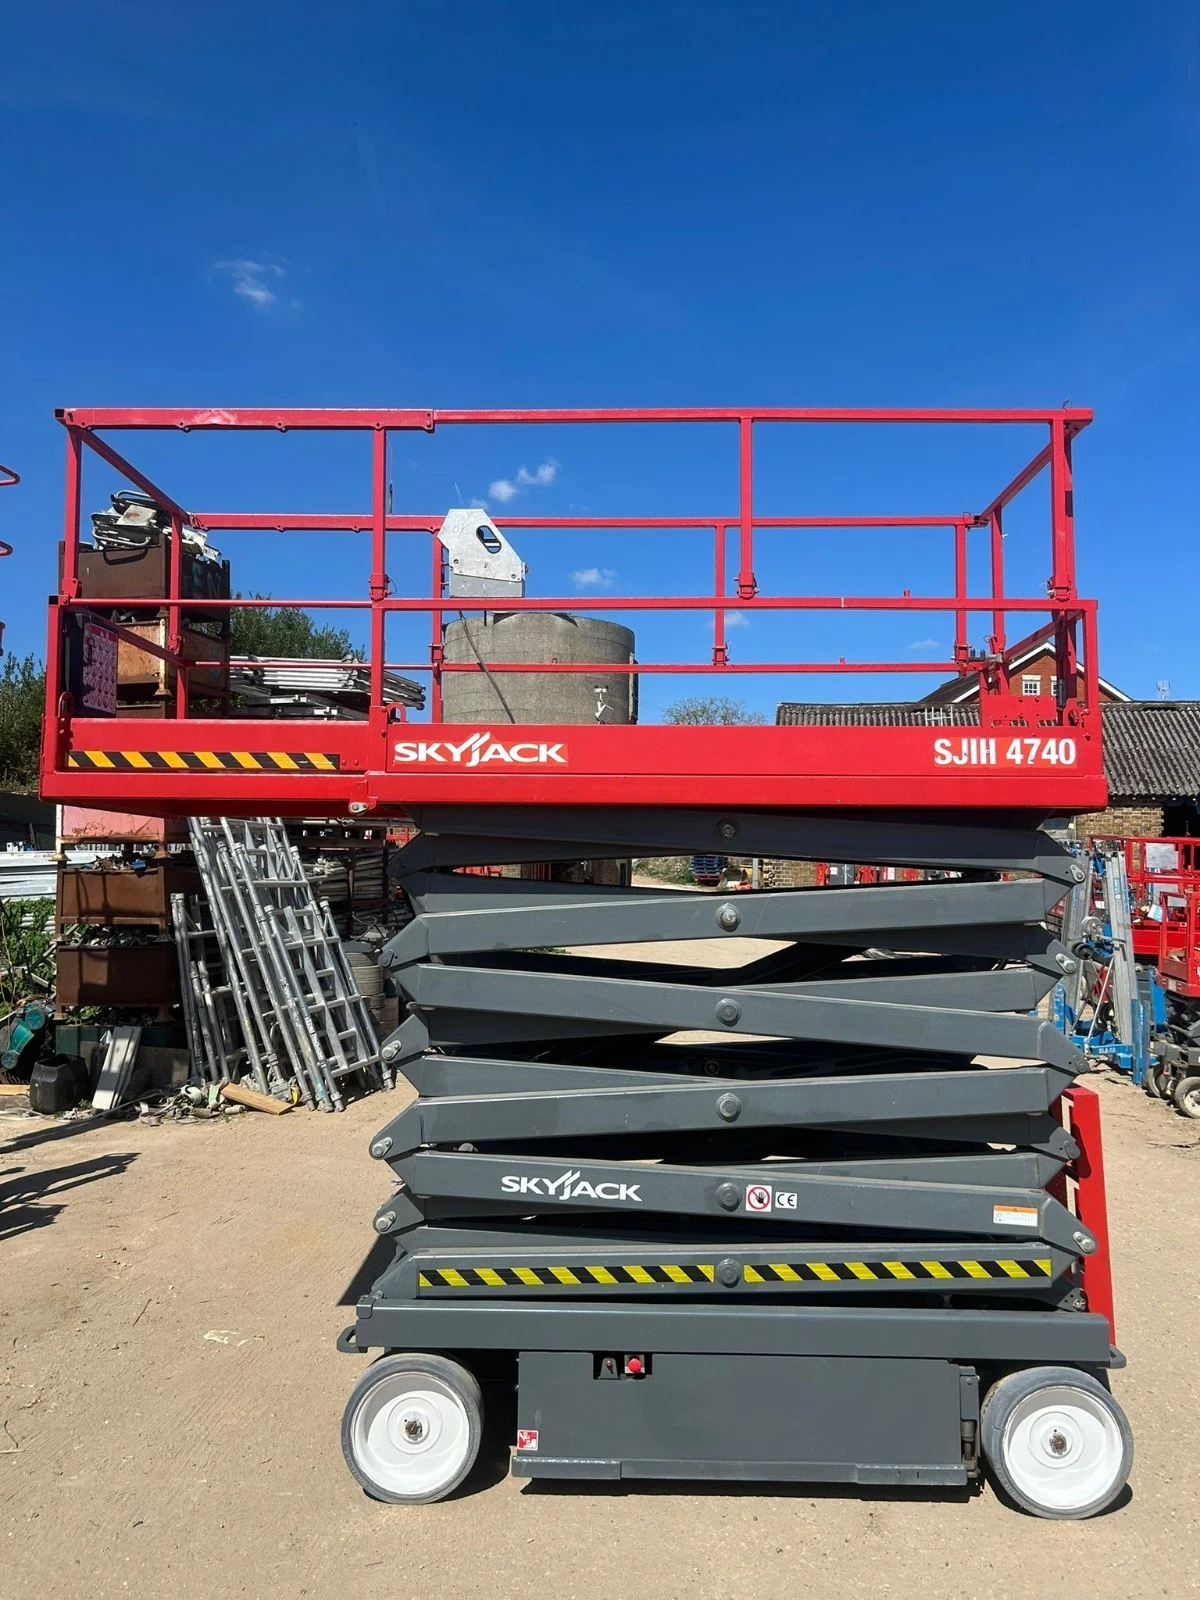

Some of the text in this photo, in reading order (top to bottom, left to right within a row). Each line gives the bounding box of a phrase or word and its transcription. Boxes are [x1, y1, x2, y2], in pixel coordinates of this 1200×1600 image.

[394, 731, 568, 767] SKYJACK
[1005, 738, 1076, 765] 4740
[501, 1169, 643, 1202] SKYJACK
